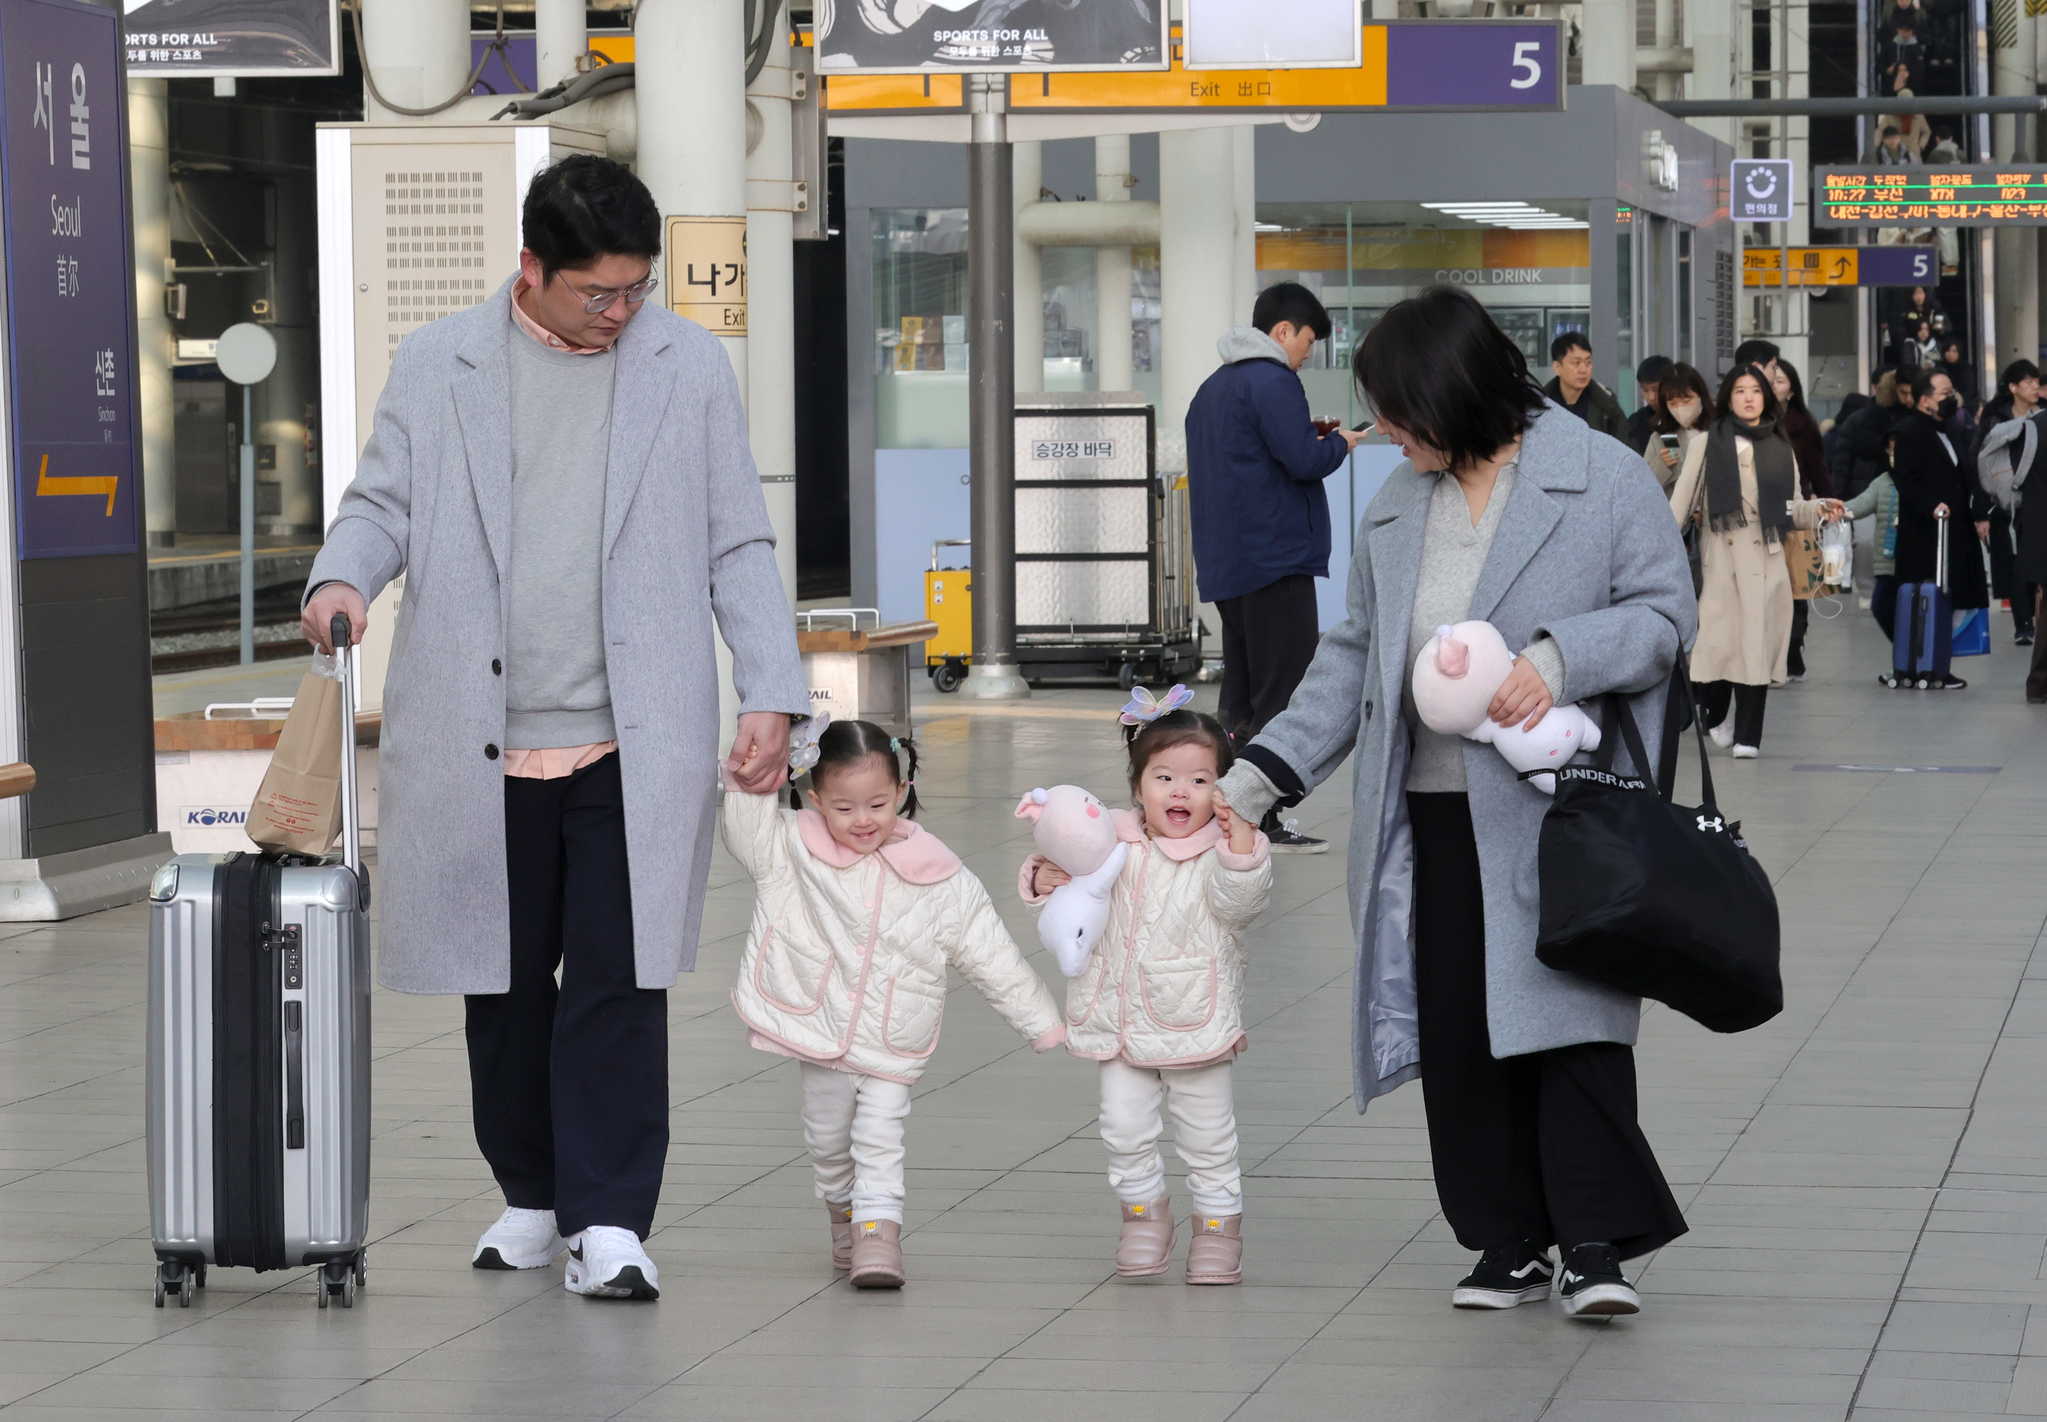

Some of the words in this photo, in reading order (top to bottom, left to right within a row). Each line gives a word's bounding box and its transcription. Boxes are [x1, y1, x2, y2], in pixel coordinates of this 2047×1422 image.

[161, 33, 189, 45] FOR
[192, 33, 218, 45] ALL
[933, 29, 989, 42] SPORTS
[992, 28, 1020, 41] FOR
[1023, 28, 1048, 41] ALL
[126, 49, 147, 62] 두를
[150, 49, 170, 62] 위한
[172, 49, 203, 61] 스포츠
[1002, 45, 1032, 56] 스포츠
[1509, 41, 1542, 90] 5
[1190, 81, 1220, 97] Exit
[1238, 81, 1271, 97] 出口
[33, 61, 91, 171] 서울
[51, 194, 82, 238] Seoul
[1745, 202, 1778, 215] 편의점
[1913, 254, 1928, 277] 5
[56, 254, 80, 297] 首尔
[687, 263, 747, 297] 나가
[1435, 269, 1486, 284] COOL
[1492, 268, 1542, 283] DRINK
[724, 308, 745, 326] Exit
[95, 347, 116, 396] 신촌
[1036, 442, 1080, 458] 승강장
[1084, 442, 1112, 457] 바닥
[1560, 768, 1618, 784] UNDER
[187, 808, 246, 826] KORAI
